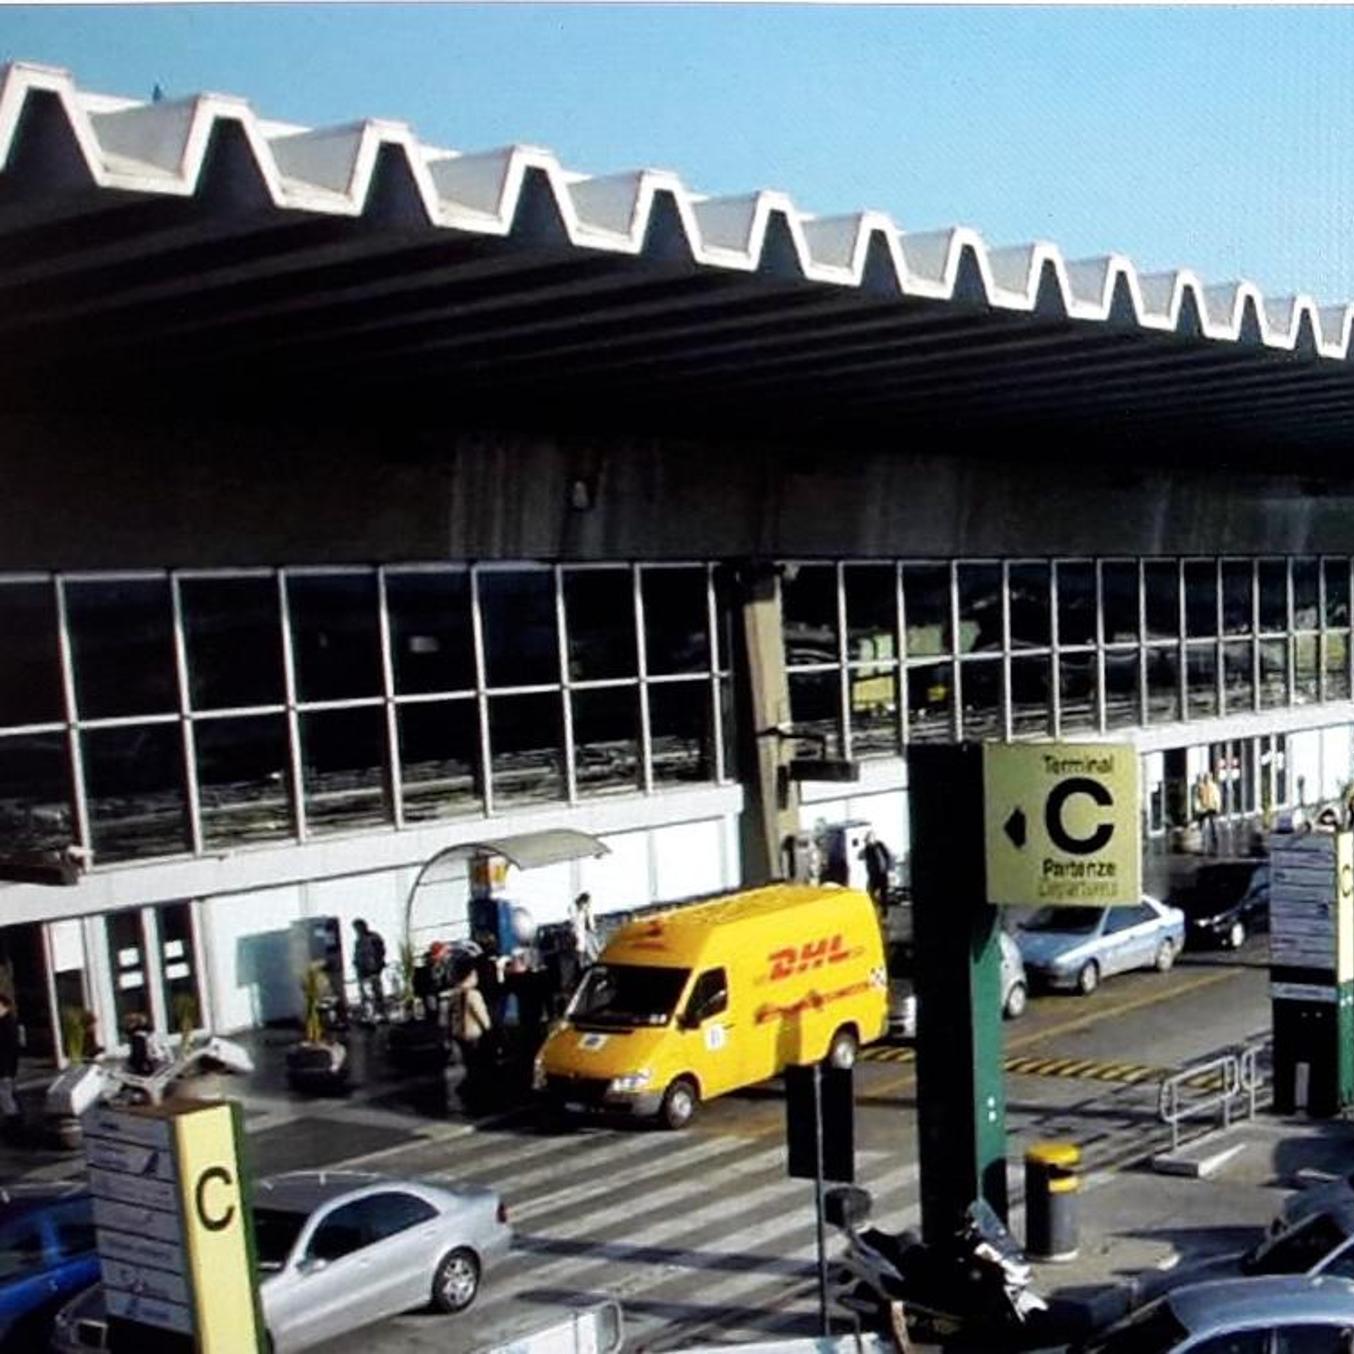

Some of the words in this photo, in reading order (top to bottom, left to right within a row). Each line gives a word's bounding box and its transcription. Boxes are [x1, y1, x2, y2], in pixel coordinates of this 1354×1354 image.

[1043, 754, 1114, 774] Terminal
[1045, 777, 1115, 855] C
[1043, 858, 1116, 877] Partenze
[768, 934, 850, 980] DHL
[196, 1166, 235, 1232] C
